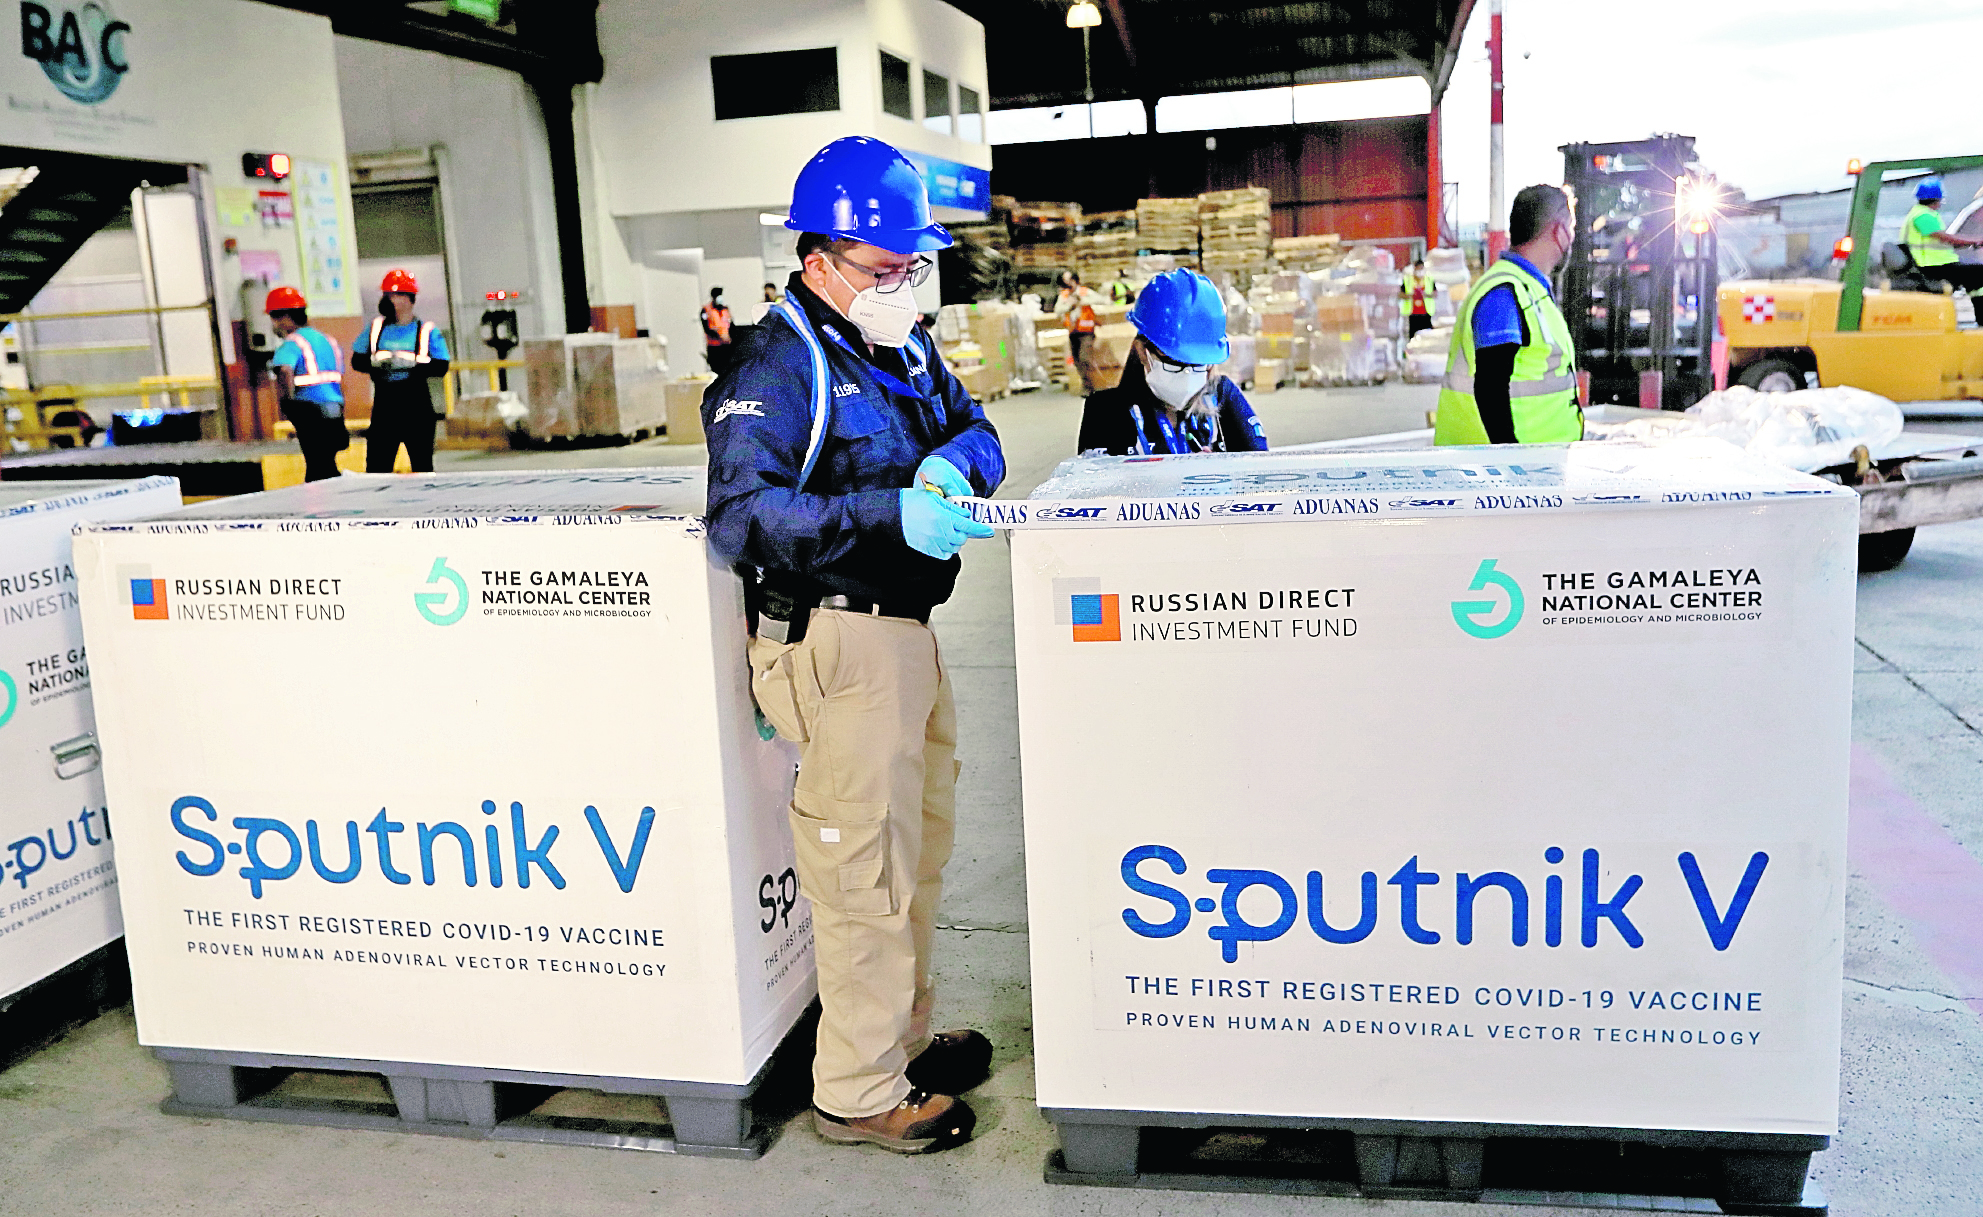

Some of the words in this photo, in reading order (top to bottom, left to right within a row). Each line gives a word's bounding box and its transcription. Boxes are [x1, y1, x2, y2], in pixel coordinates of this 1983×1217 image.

[1116, 501, 1201, 521] ADUANAS
[1292, 498, 1380, 516] ADUANAS
[1474, 494, 1563, 510] ADUANAS
[175, 579, 261, 596] RUSSIAN
[269, 579, 342, 596] DIRECT
[481, 570, 522, 586] THE
[529, 570, 649, 587] GAMALEYA
[1542, 572, 1595, 591] THE
[1607, 568, 1762, 589] GAMALEYA
[482, 590, 574, 605] NATIONAL
[578, 590, 651, 606] CENTER
[1131, 591, 1247, 613] RUSSIAN
[1259, 588, 1356, 610] DIRECT
[1542, 593, 1663, 612] NATIONAL
[1670, 591, 1762, 609] CENTER
[177, 603, 289, 621] INVESTMENT
[295, 604, 345, 621] FUND
[483, 608, 495, 616] OF
[497, 608, 560, 617] EPIDEMIOLOGY
[562, 609, 582, 617] AND
[584, 609, 652, 617] MICROBIOLOGY
[1542, 617, 1558, 625] OF
[1561, 615, 1644, 625] EPIDEMIOLOGY
[1647, 615, 1672, 623] AND
[1675, 612, 1762, 622] MICROBIOLOGY
[1132, 619, 1283, 641] INVESTMENT
[1292, 618, 1357, 638] FUND
[26, 654, 61, 677] THE
[170, 795, 567, 900] Sputnik
[583, 805, 656, 894] V
[9, 891, 44, 915] FIRST
[1120, 844, 1644, 964] Sputnik
[1677, 851, 1770, 952] V
[183, 909, 223, 927] THE
[231, 912, 290, 931] FIRST
[299, 916, 432, 938] REGISTERED
[442, 922, 550, 943] COVID-19
[559, 926, 664, 947] VACCINE
[187, 941, 254, 957] PROVEN
[262, 946, 324, 960] HUMAN
[333, 949, 447, 968] ADENOVIRAL
[455, 956, 529, 971] VECTOR
[537, 958, 666, 977] TECHNOLOGY
[764, 949, 779, 971] THE
[1125, 975, 1179, 996] THE
[1191, 978, 1271, 998] FIRST
[1283, 981, 1460, 1005] REGISTERED
[1475, 987, 1614, 1009] COVID-19
[1628, 991, 1762, 1012] VACCINE
[1126, 1012, 1215, 1029] PROVEN
[1228, 1016, 1310, 1032] HUMAN
[1322, 1019, 1474, 1038] ADENOVIRAL
[1487, 1025, 1581, 1041] VECTOR
[1593, 1027, 1761, 1046] TECHNOLOGY
